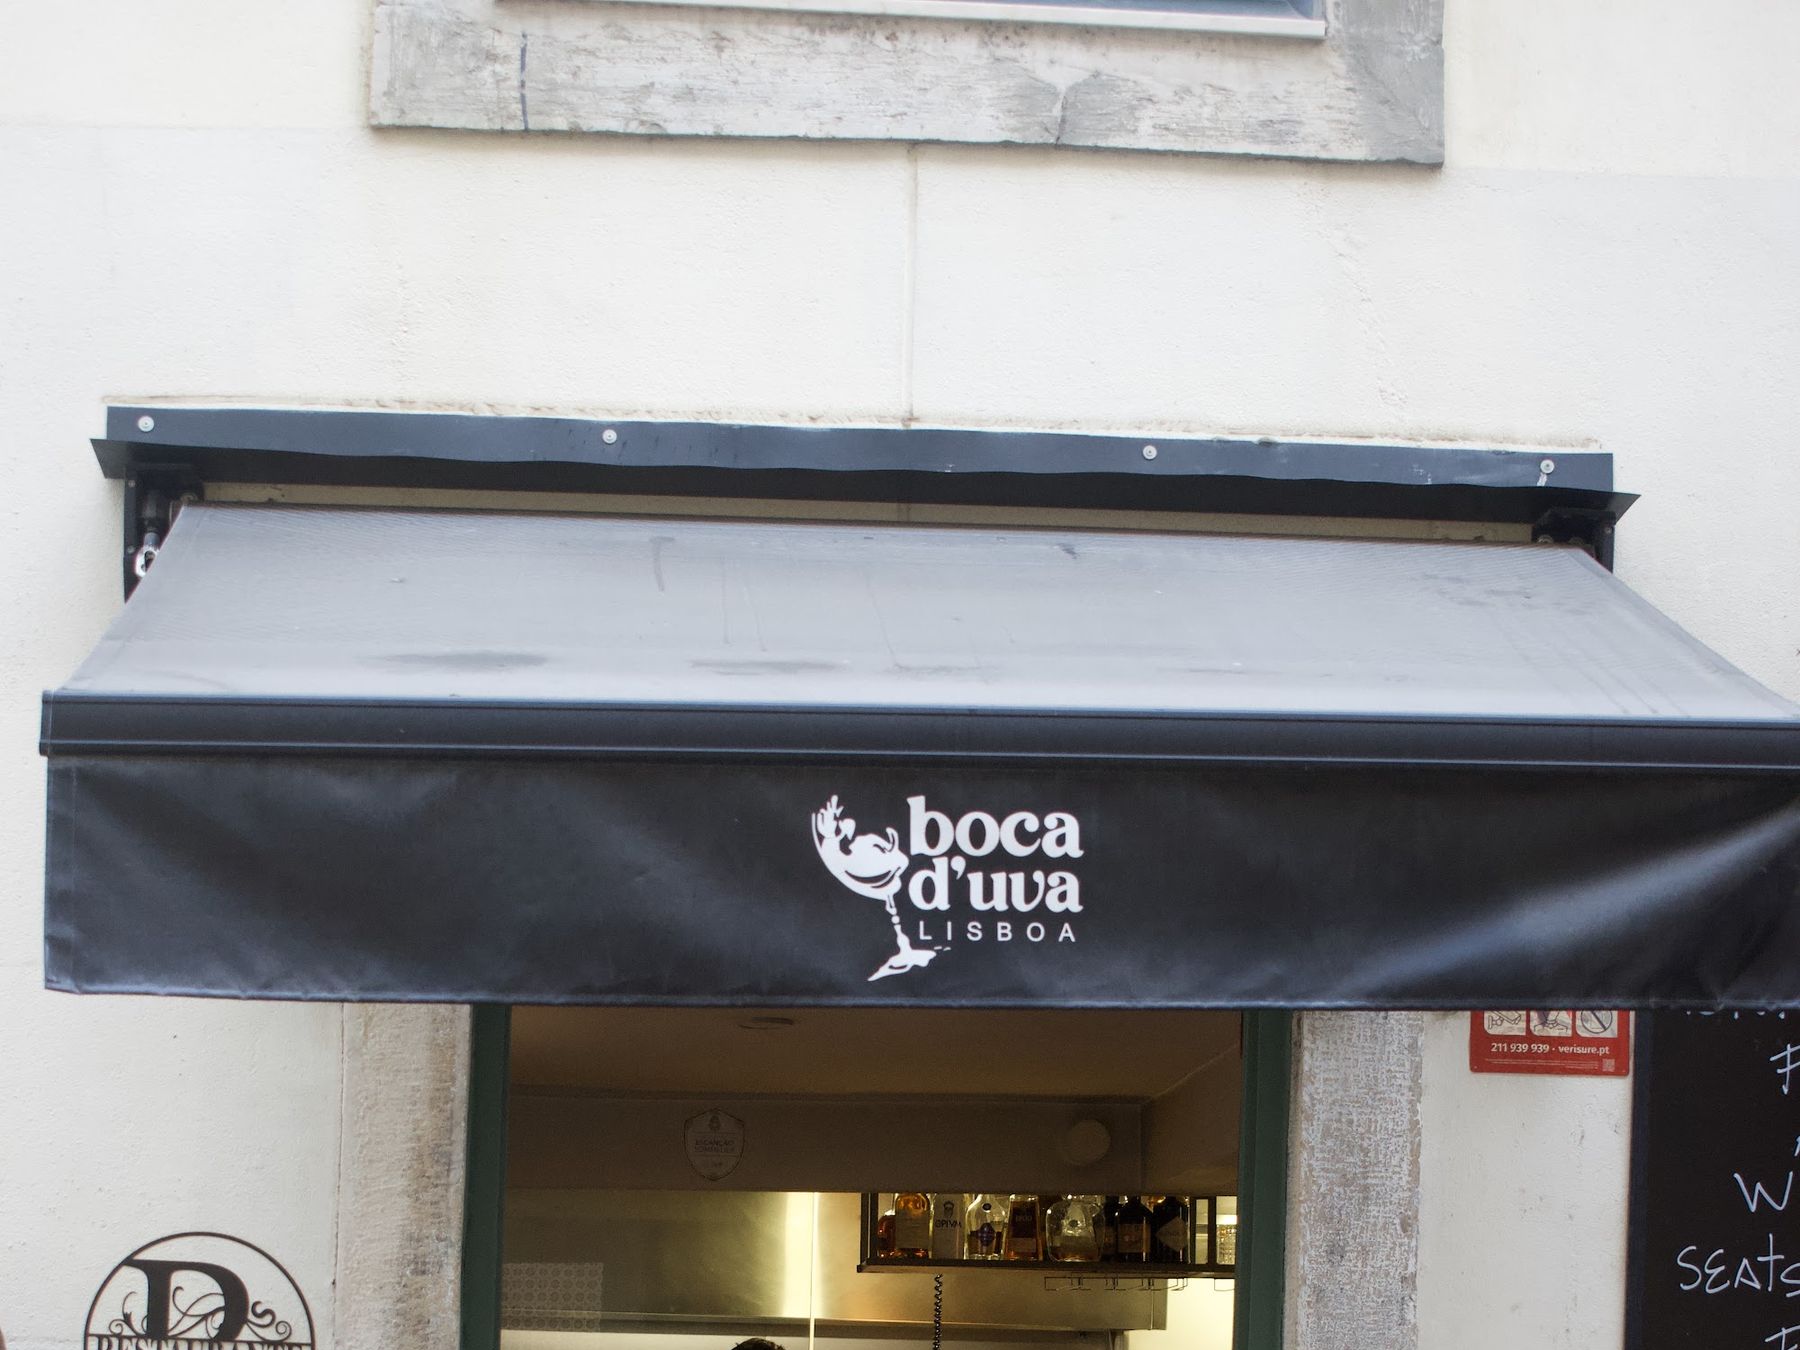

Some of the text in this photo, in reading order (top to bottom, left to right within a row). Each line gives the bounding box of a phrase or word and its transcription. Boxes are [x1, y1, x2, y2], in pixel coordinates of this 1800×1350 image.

[907, 795, 1084, 858] boca
[908, 856, 1084, 913] d'uva
[919, 921, 1076, 942] LISBOA
[1490, 1042, 1610, 1055] 211 939 939 verisure.pt
